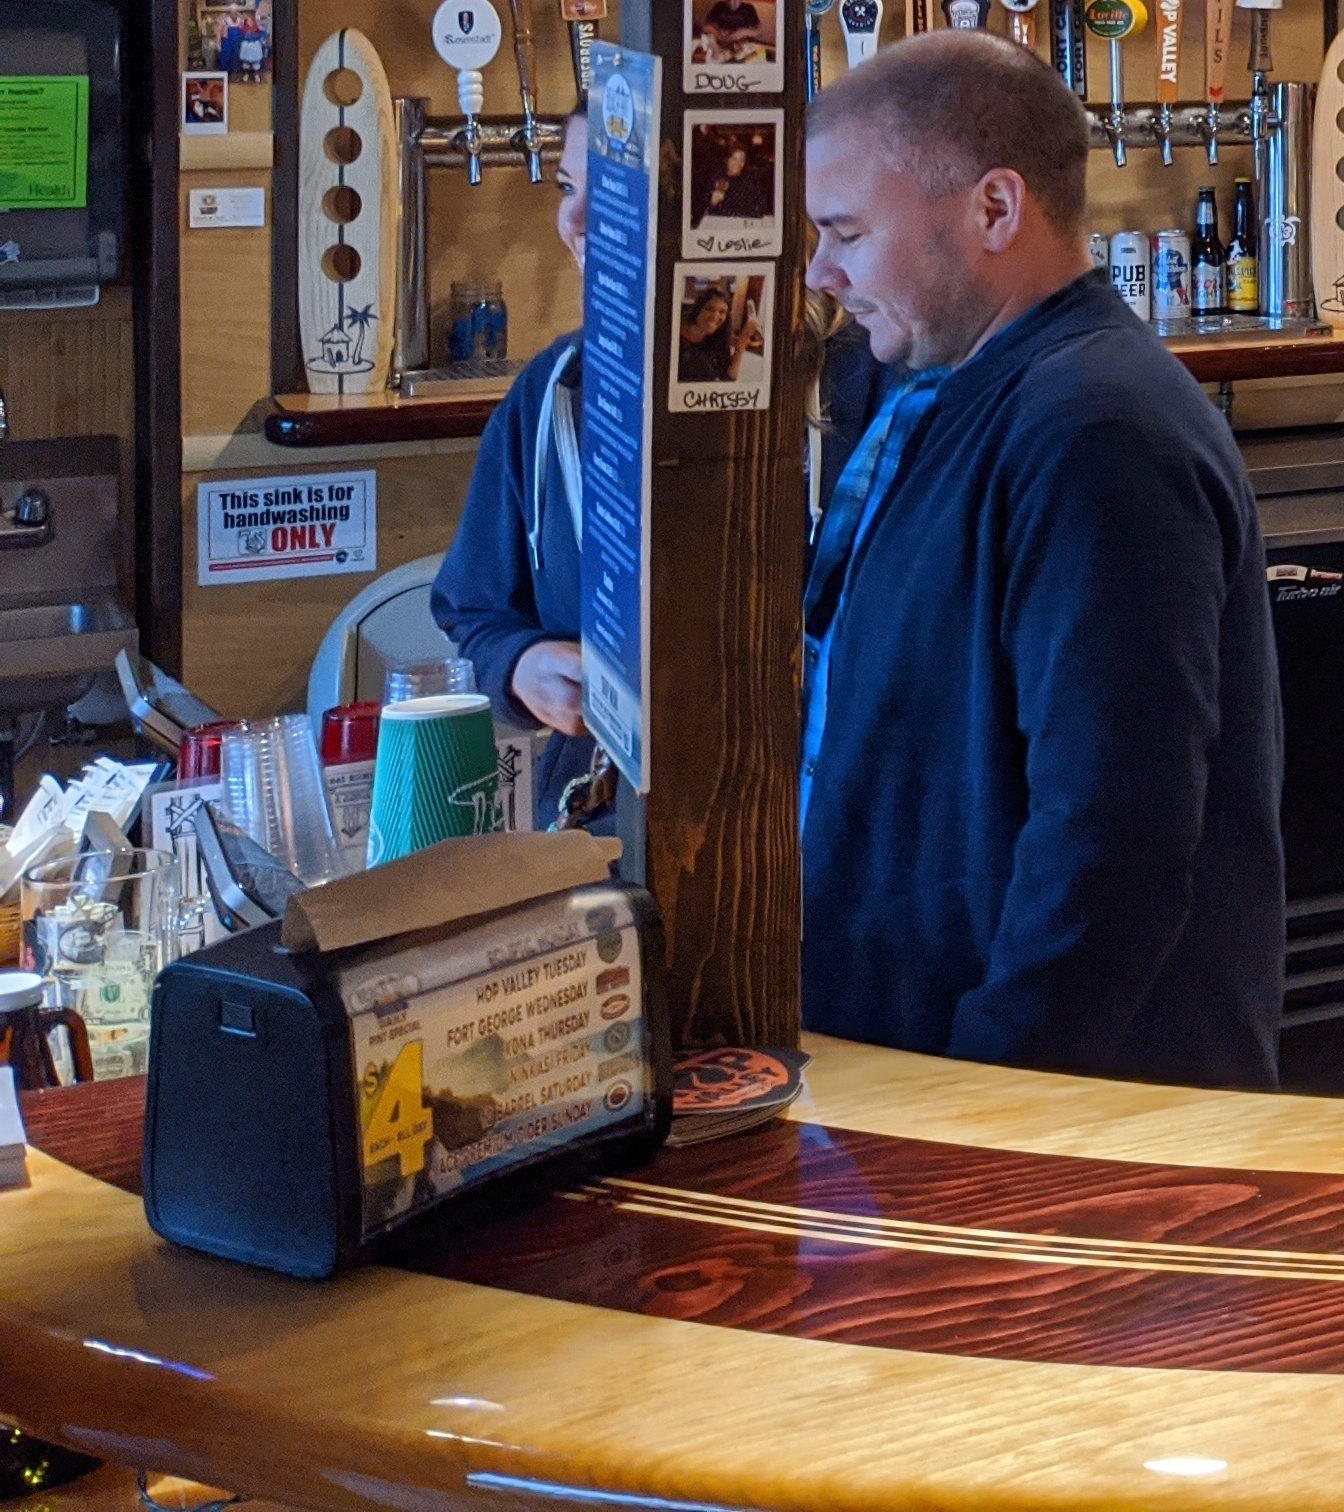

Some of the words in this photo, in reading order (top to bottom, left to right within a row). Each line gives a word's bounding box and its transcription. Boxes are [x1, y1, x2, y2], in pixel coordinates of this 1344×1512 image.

[1161, 23, 1178, 84] VALLEY
[1112, 265, 1146, 283] PUB
[683, 389, 760, 411] CHRISSY
[219, 491, 260, 511] This
[263, 487, 303, 507] sink
[307, 486, 324, 503] is
[328, 485, 355, 501] for
[223, 505, 350, 529] handwashing
[271, 522, 337, 553] ONLY
[501, 967, 539, 996] VALLEY
[543, 949, 587, 981] TUESDAY
[447, 1021, 475, 1049] FORT
[478, 1004, 522, 1036] GEORGE
[526, 980, 588, 1017] WEDNESDAY
[538, 1010, 590, 1043] THURSDAY
